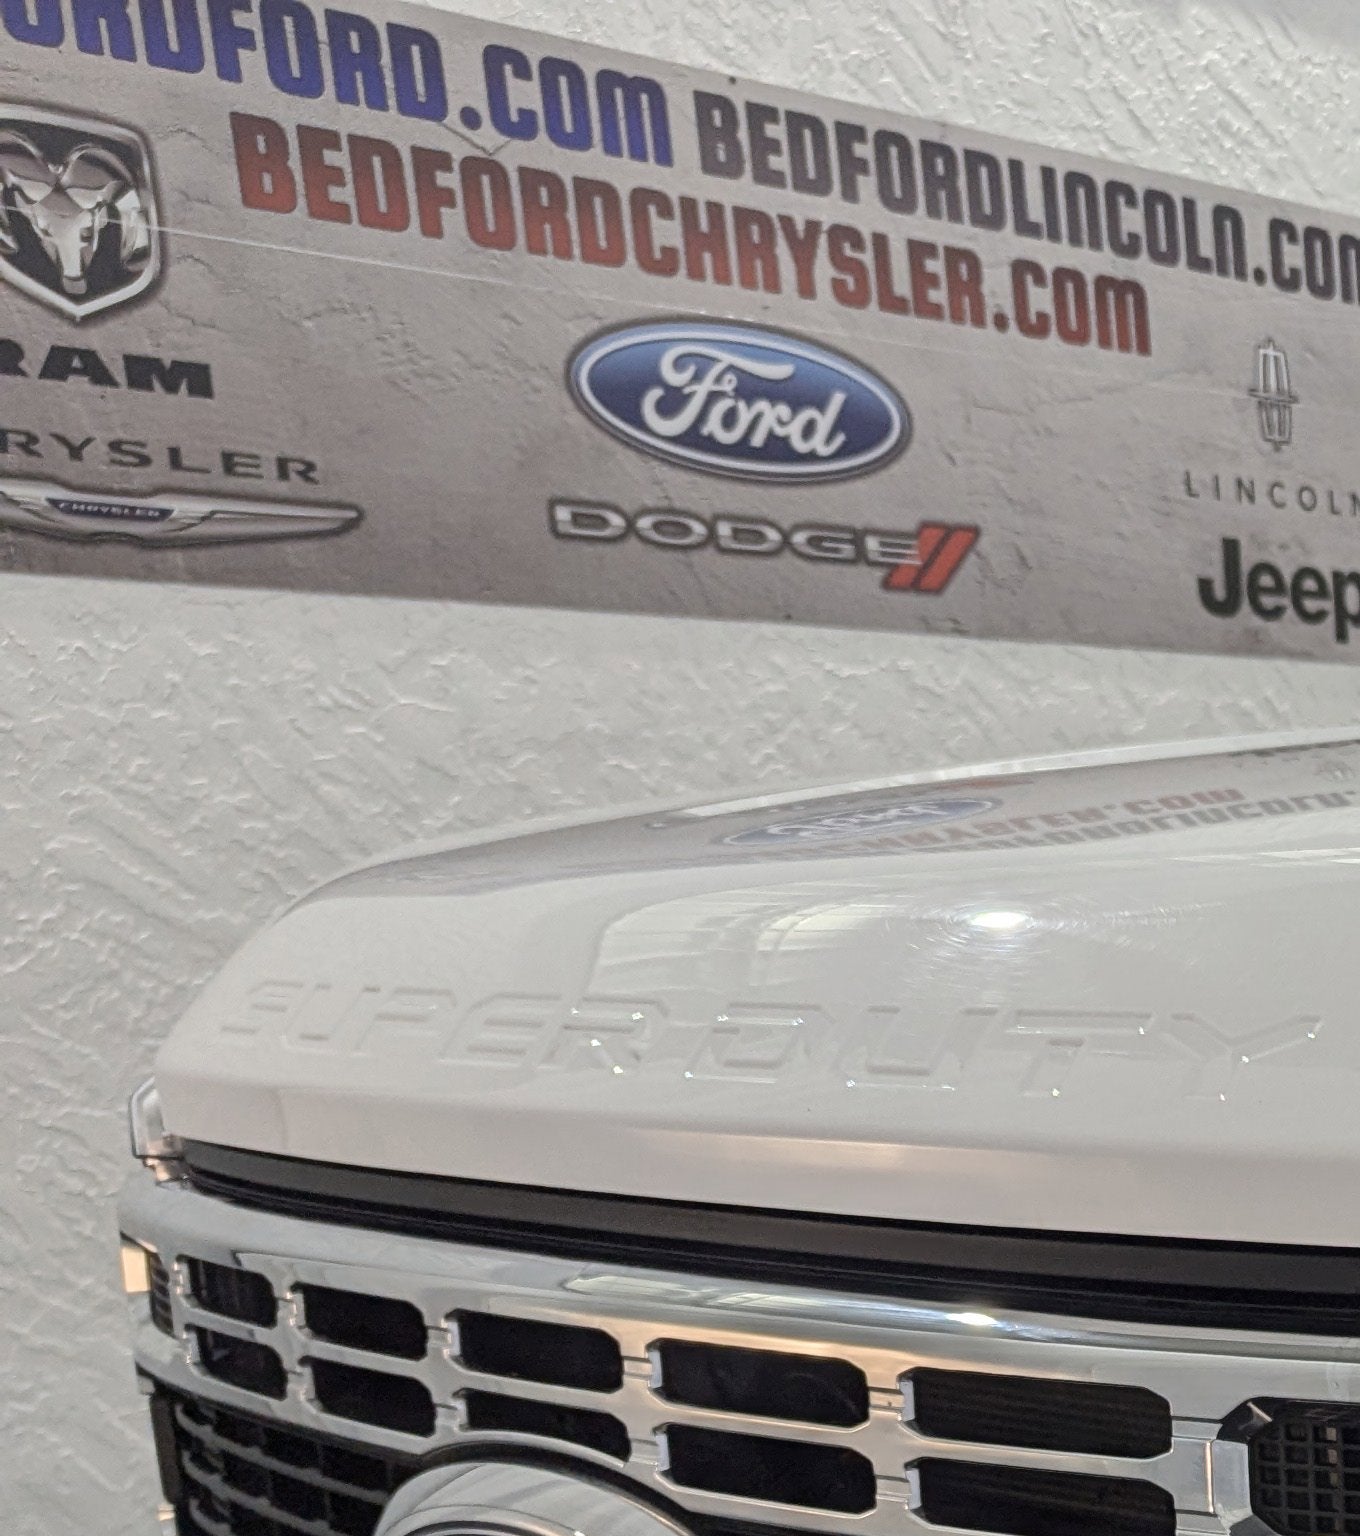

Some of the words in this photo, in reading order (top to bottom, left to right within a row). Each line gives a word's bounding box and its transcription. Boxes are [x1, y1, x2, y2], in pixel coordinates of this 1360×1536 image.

[229, 110, 1153, 358] BEDFORDCHRYSLER.COM
[641, 343, 847, 458] Ford
[550, 499, 924, 567] DODGE
[219, 979, 669, 1073] SUPER
[683, 1001, 1324, 1101] DUTY
